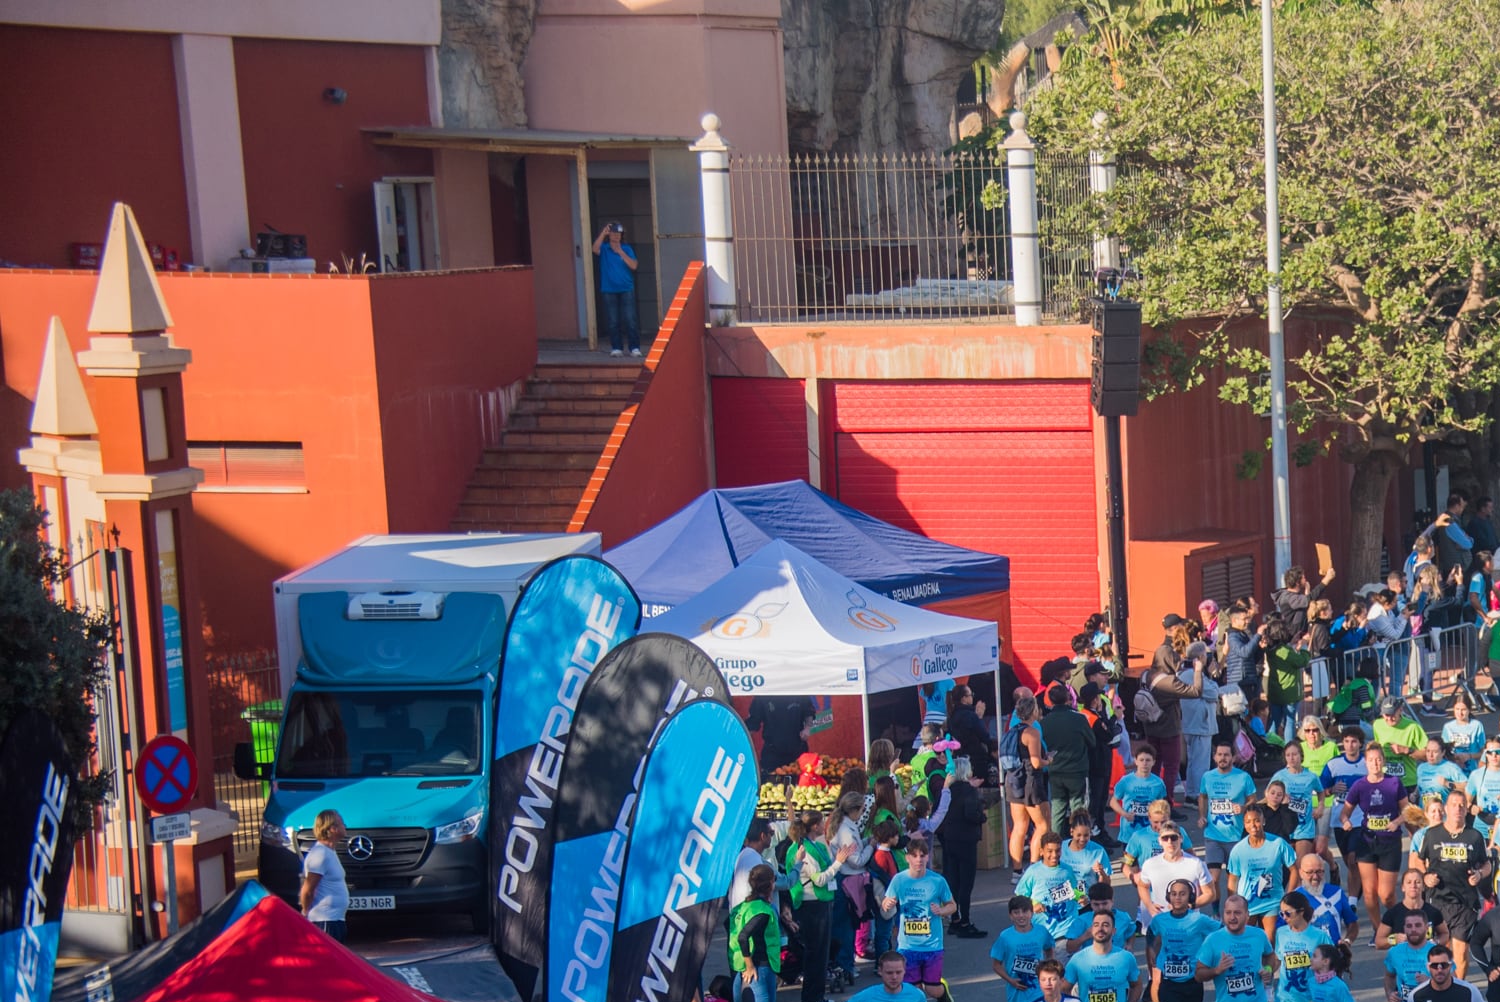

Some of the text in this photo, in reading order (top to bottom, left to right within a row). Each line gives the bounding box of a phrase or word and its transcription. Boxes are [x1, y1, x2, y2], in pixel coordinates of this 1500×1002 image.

[892, 581, 941, 601] BENALMADENA
[934, 643, 953, 657] Grupo
[715, 657, 757, 671] Grupo
[924, 657, 958, 676] Gallego
[498, 592, 623, 914] POWERADE
[1133, 804, 1148, 814] 263
[371, 895, 393, 909] NGR
[1166, 965, 1188, 974] 2865
[1229, 978, 1252, 990] 2610
